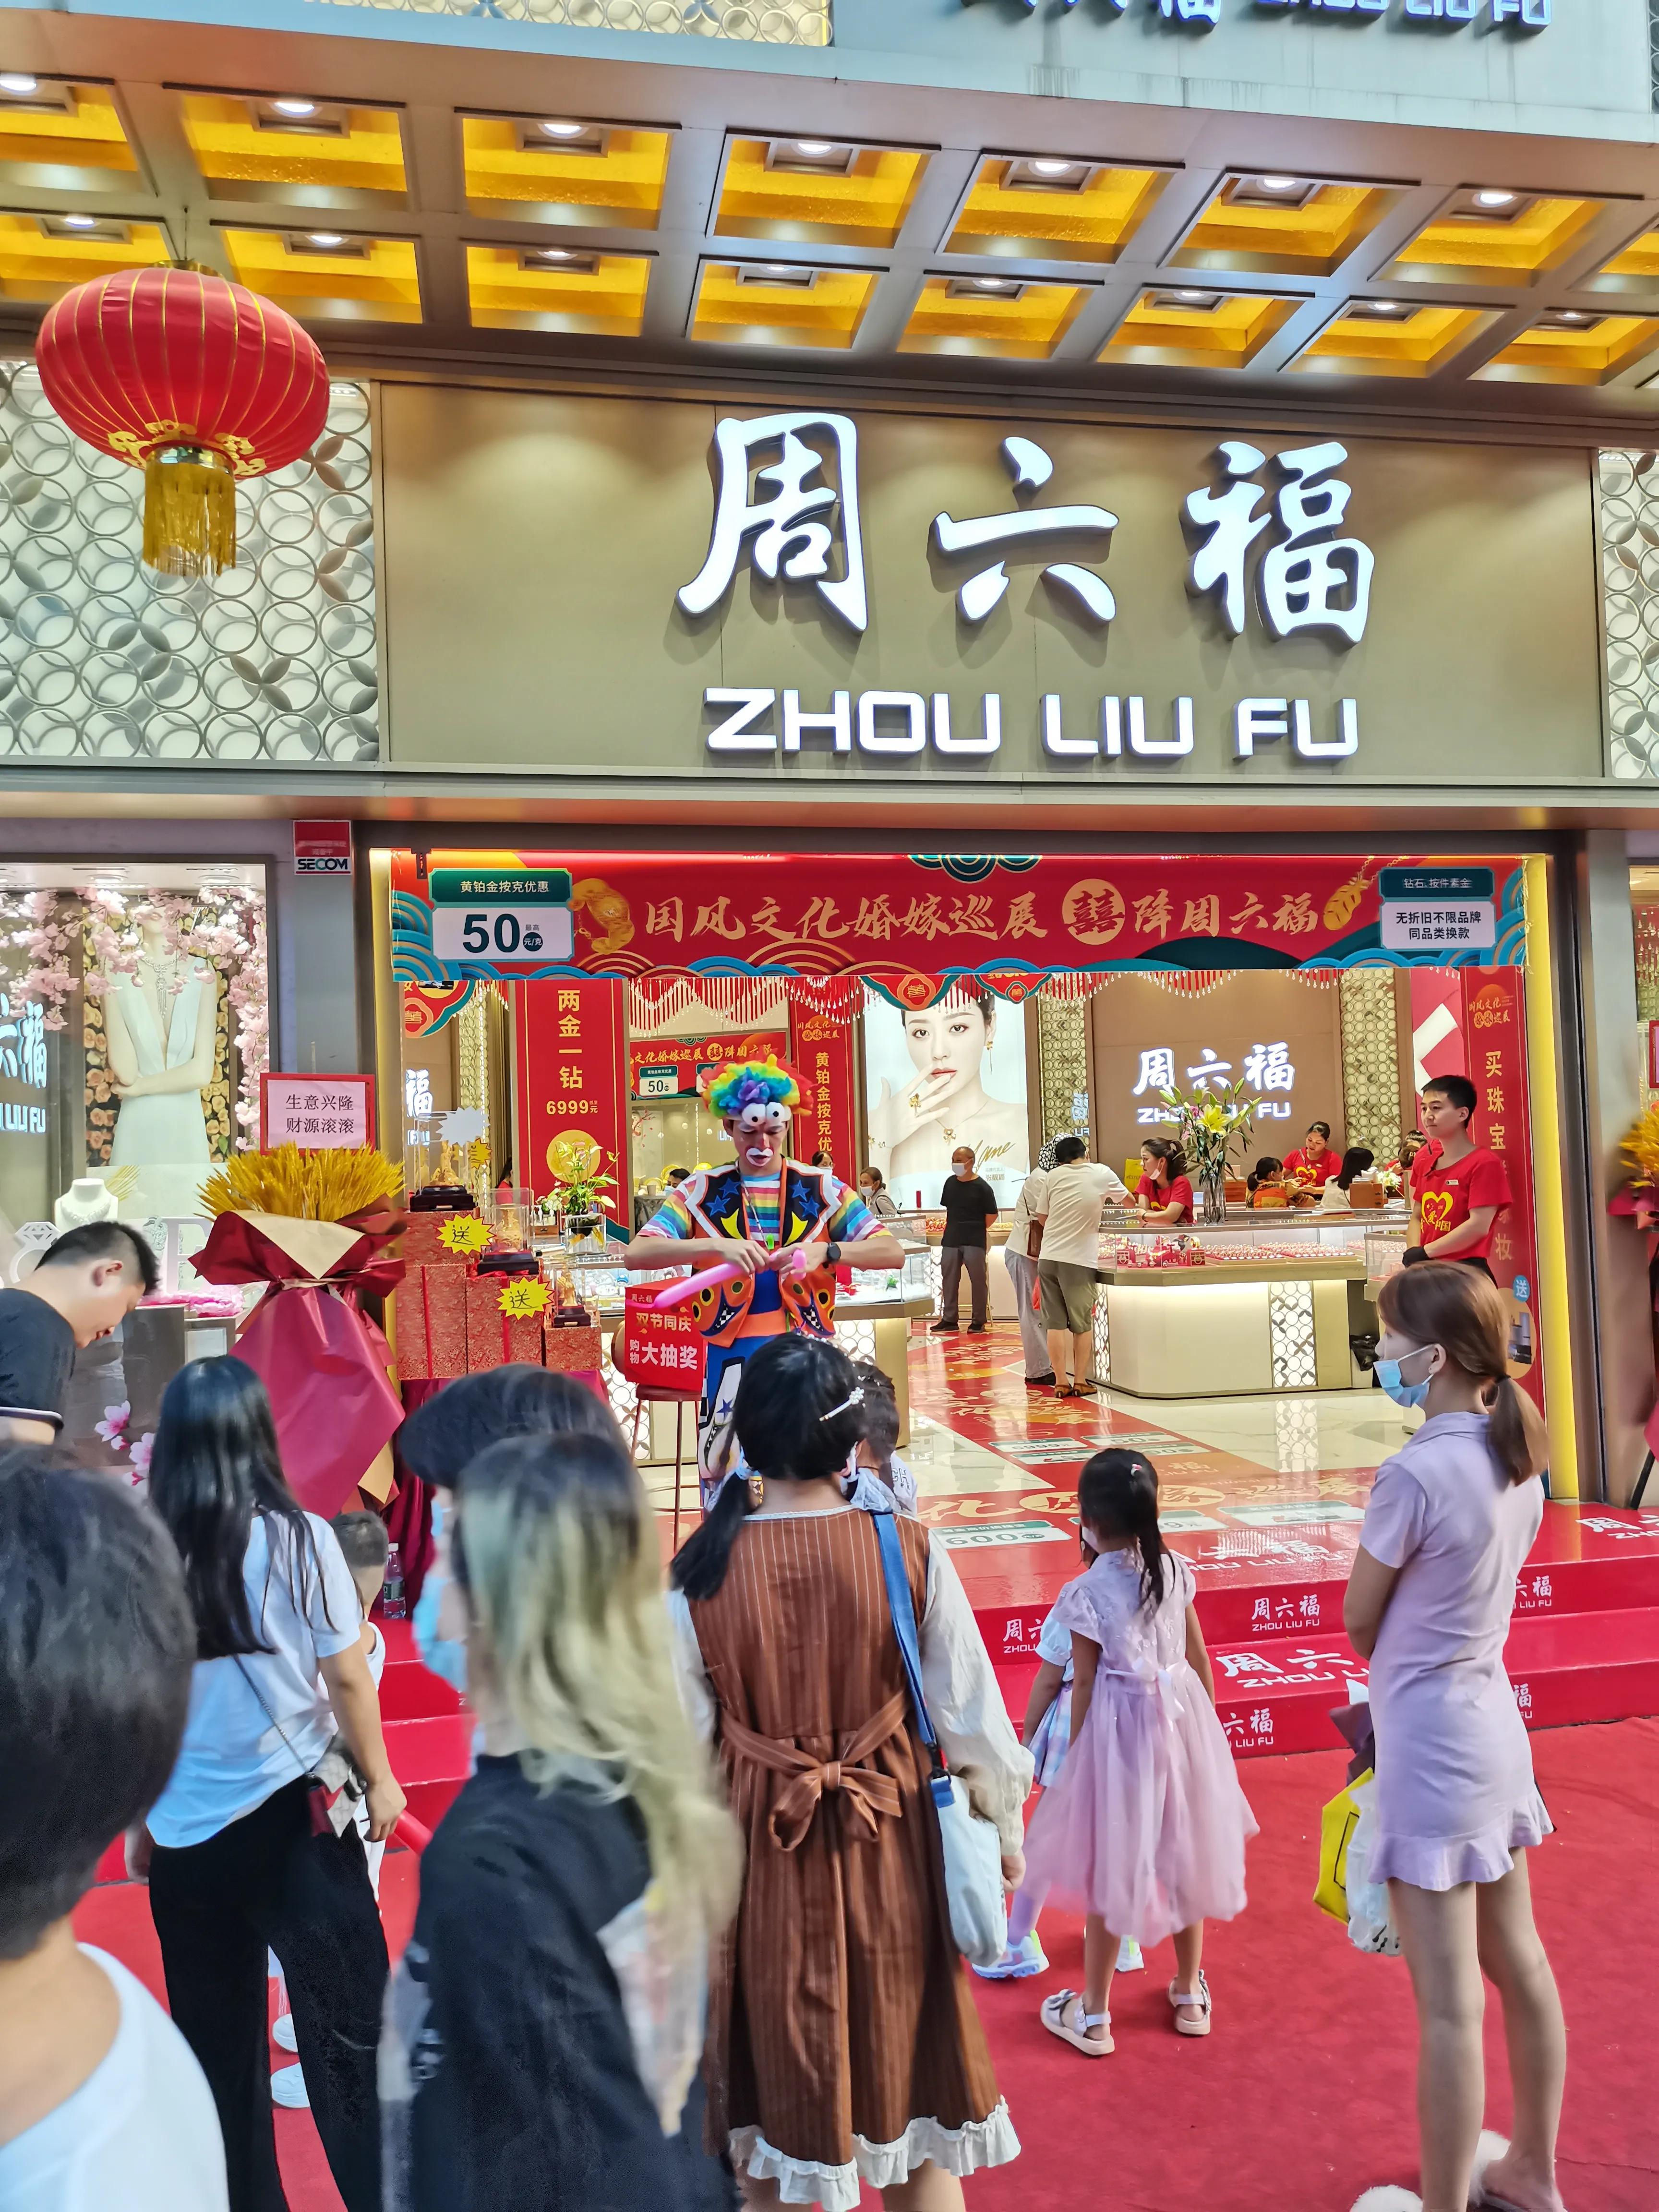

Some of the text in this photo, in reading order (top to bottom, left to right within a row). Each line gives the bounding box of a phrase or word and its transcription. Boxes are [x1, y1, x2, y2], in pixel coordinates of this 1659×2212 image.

[676, 412, 1375, 644] 周六福
[704, 687, 1358, 761] ZHOU LIU FU
[298, 858, 348, 870] SECOM
[459, 880, 550, 894] 黄铂金按克优惠
[646, 890, 1048, 943] 国风文化婚嫁巡展
[1131, 888, 1319, 939] 降周六福
[1395, 911, 1481, 926] 无折旧不限品牌
[462, 913, 521, 954] 50
[1408, 926, 1470, 941] 同品类换款
[557, 989, 583, 1090] 两金一钻
[1132, 1041, 1295, 1096] 周六福
[648, 1080, 663, 1093] 50
[286, 1094, 354, 1111] 生意兴隆
[546, 1099, 589, 1115] 6999
[815, 1052, 833, 1152] 黄铂金按克优
[1258, 1102, 1291, 1118] FU
[286, 1117, 355, 1134] 财源滚滚
[450, 1225, 475, 1246] 送
[1515, 1280, 1528, 1298] 送
[508, 1288, 539, 1310] 送
[631, 1293, 653, 1304] 周六福
[636, 1312, 692, 1333] 双节同庆
[629, 1339, 640, 1364] 购物
[641, 1341, 698, 1370] 大抽奖
[946, 1533, 1018, 1545] 600
[1251, 1594, 1320, 1621] 周六福
[1519, 1599, 1536, 1609] LIU
[1538, 1599, 1552, 1608] FU
[1251, 1618, 1320, 1632] ZHOU LIU FU
[1003, 1644, 1037, 1654] ZHOU
[1236, 1672, 1336, 1688] ZHOU
[1235, 1738, 1254, 1748] LIU
[1258, 1736, 1274, 1746] FU
